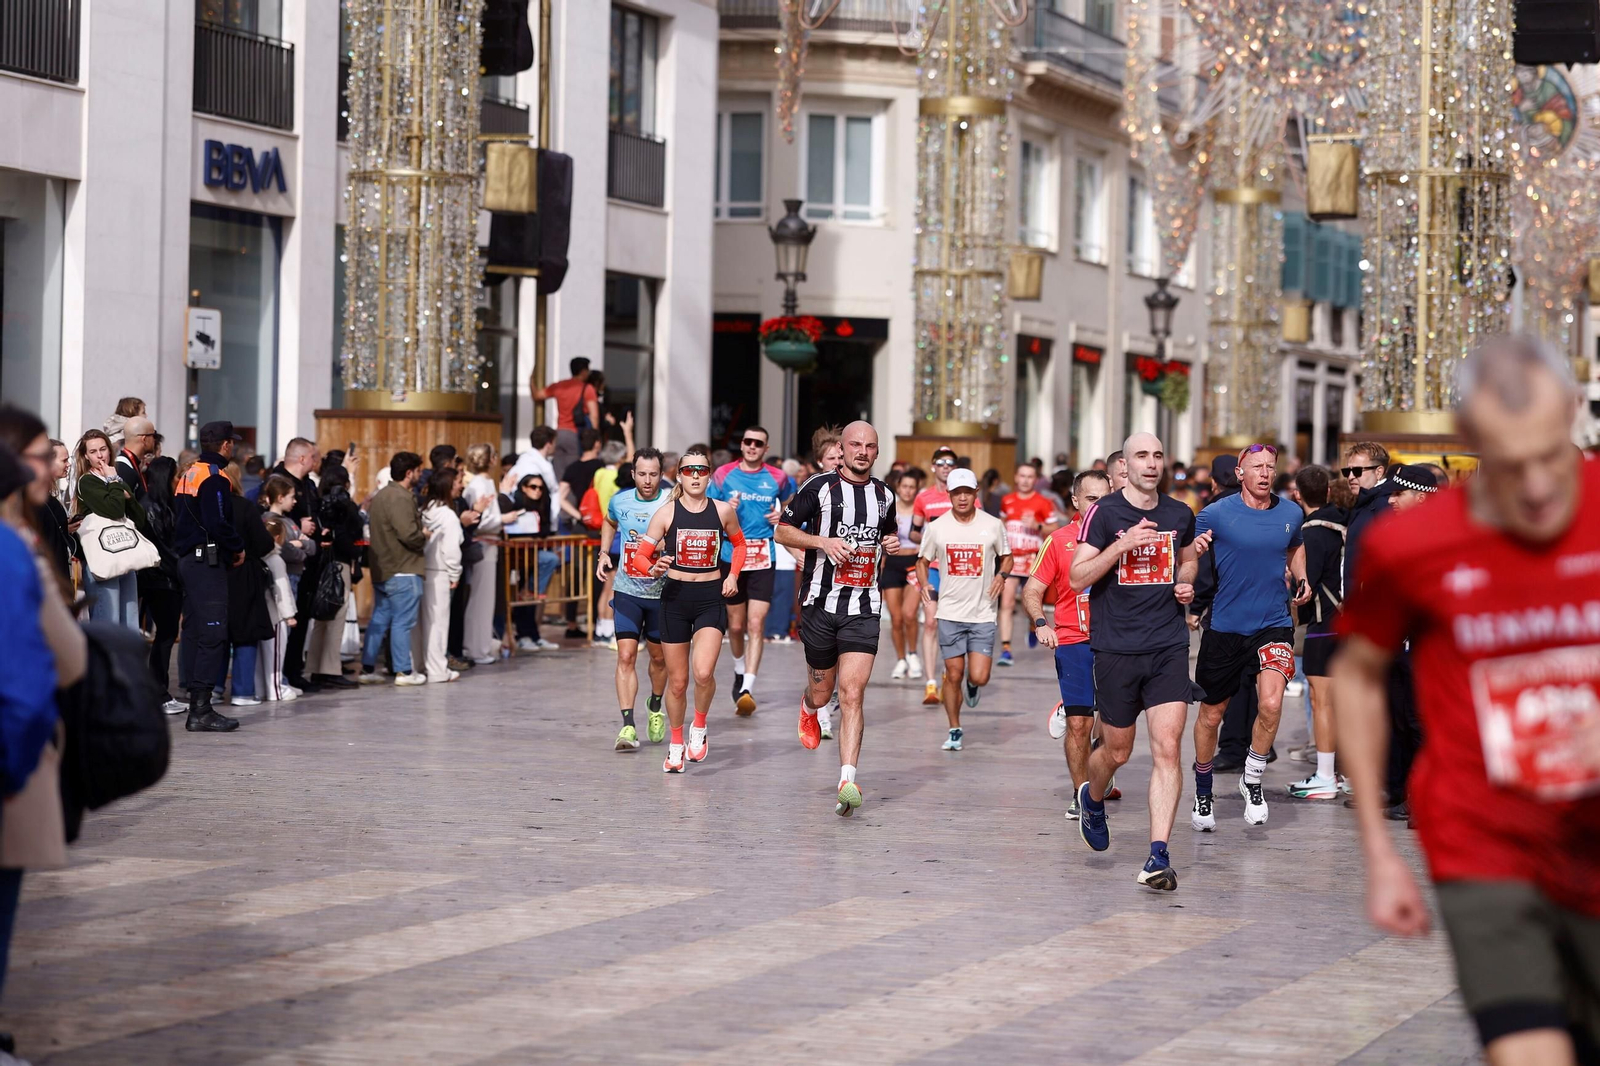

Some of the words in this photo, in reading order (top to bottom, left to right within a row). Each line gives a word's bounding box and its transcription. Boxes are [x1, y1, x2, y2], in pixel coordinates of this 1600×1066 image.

[204, 139, 286, 194] BBVA
[741, 491, 773, 503] BeForm
[686, 539, 708, 547] 8408
[953, 551, 973, 559] 7117
[1132, 546, 1157, 556] 6142
[849, 555, 869, 565] 8409
[1269, 647, 1291, 659] 9033
